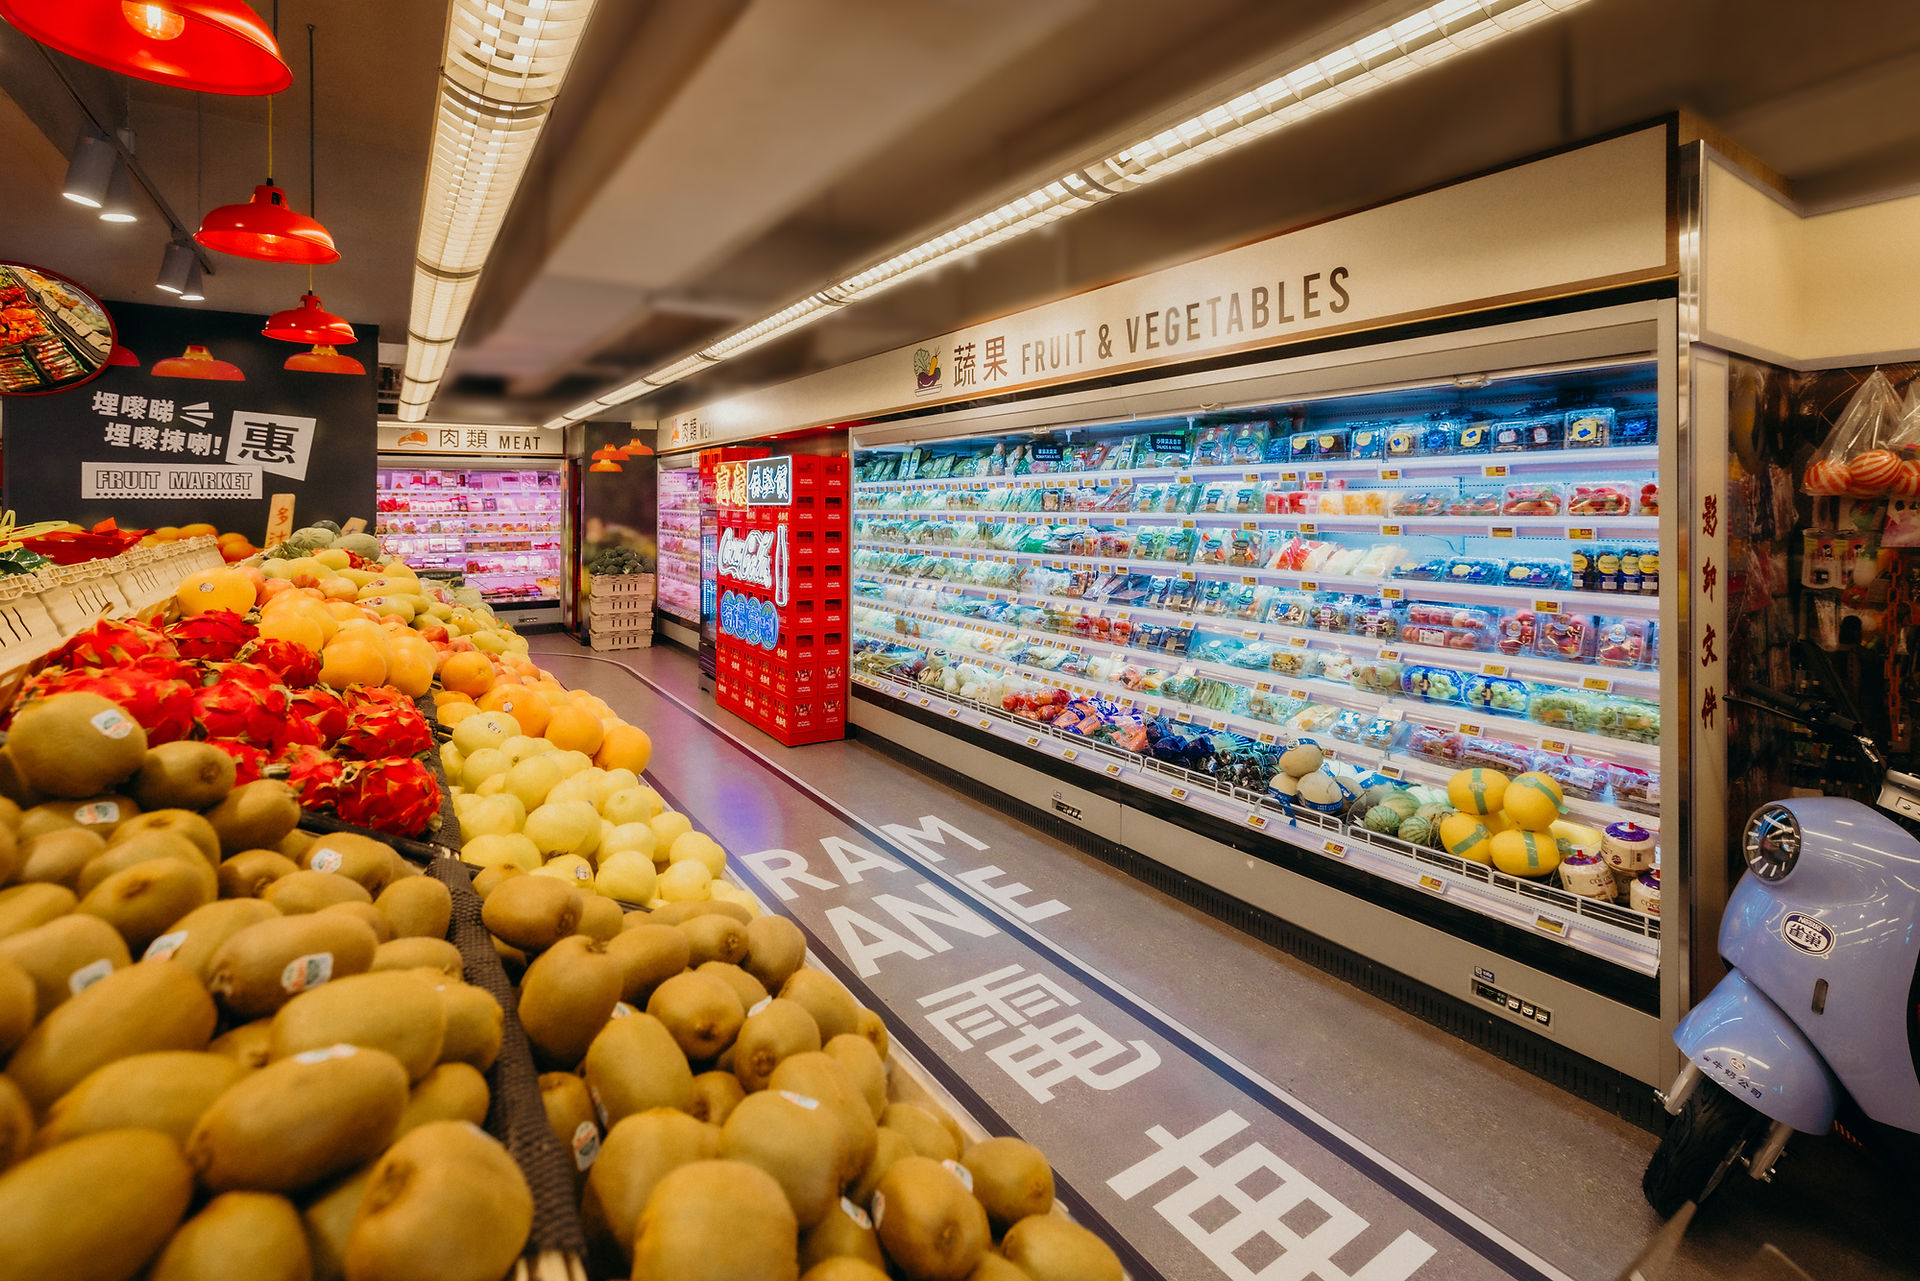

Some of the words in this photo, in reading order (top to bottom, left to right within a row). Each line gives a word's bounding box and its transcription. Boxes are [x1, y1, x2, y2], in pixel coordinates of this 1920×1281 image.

[952, 334, 1009, 388] 蔬果
[1020, 328, 1087, 376] FRUIT
[1097, 323, 1114, 360] &
[1126, 265, 1351, 354] VEGETABLES
[92, 390, 175, 424] 埋嚟睇
[237, 420, 300, 465] 惠
[439, 428, 488, 449] 肉類
[499, 435, 541, 450] MEAT
[96, 470, 160, 490] FRUIT
[168, 471, 253, 490] MARKET
[1789, 923, 1822, 949] 雀巢
